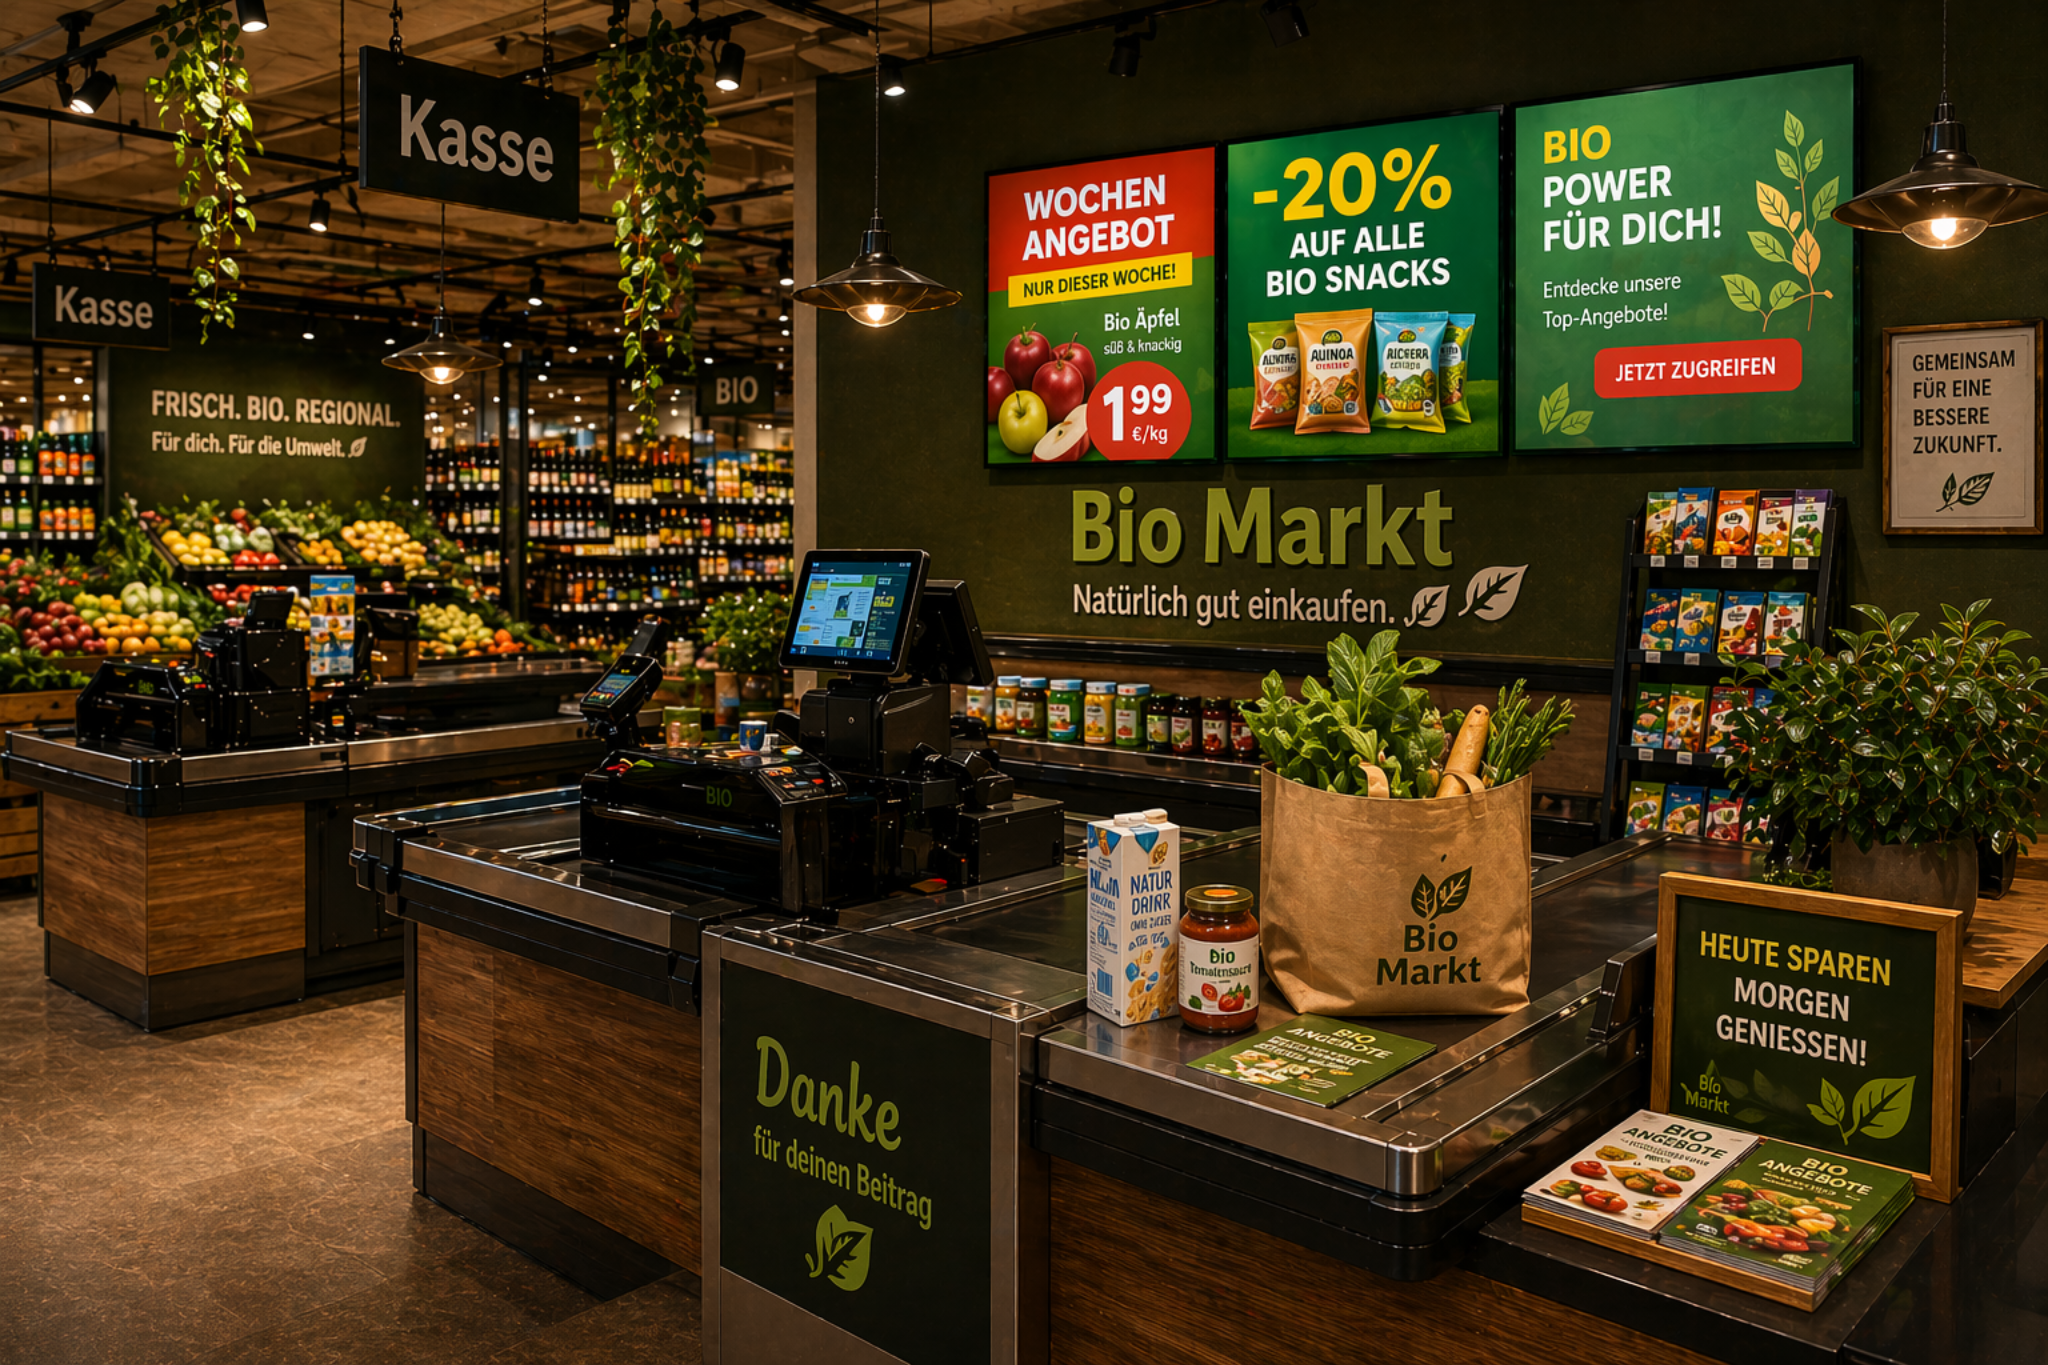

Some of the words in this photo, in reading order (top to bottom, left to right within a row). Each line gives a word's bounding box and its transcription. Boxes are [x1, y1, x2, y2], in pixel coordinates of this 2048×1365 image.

[400, 93, 555, 183] Kasse
[1544, 124, 1612, 164] BIO
[1023, 174, 1166, 221] WOCHEN
[1252, 143, 1453, 222] -20%
[1544, 164, 1672, 208] POWER
[1022, 213, 1175, 261] ANGEBOT
[1289, 228, 1347, 260] AUF
[1353, 222, 1426, 254] ALLE
[1544, 210, 1611, 252] FÜR
[1621, 204, 1723, 245] DICH!
[1023, 280, 1054, 298] NUR
[1058, 272, 1109, 294] DIESER
[1113, 262, 1176, 287] WOCHE!
[1266, 268, 1318, 298] BIO
[1325, 256, 1451, 294] SNACKS
[1543, 276, 1619, 299] Entdecke
[1624, 275, 1682, 293] unsere
[54, 284, 154, 330] Kasse
[1104, 312, 1130, 332] Bio
[1135, 307, 1181, 334] Äpfel
[1543, 303, 1669, 332] Top-Angebote!
[1126, 340, 1136, 354] &
[1138, 337, 1182, 354] knackig
[1912, 349, 2016, 373] GEMEINSAM
[1614, 362, 1666, 383] JETZT
[1671, 356, 1776, 381] ZUGREIFEN
[716, 376, 758, 404] BIO
[1912, 377, 1947, 400] FÜR
[1952, 378, 1992, 398] EINE
[152, 390, 242, 420] FRISCH.
[247, 395, 290, 422] BIO.
[296, 398, 401, 428] REGIONAL.
[1912, 406, 1990, 428] BESSERE
[152, 431, 182, 452] Für
[184, 432, 225, 454] dich.
[228, 434, 256, 454] Für
[258, 434, 282, 455] die
[285, 436, 346, 458] Umwelt.
[1132, 425, 1168, 444] €/kg
[1912, 433, 2002, 455] ZUKUNFT.
[1072, 485, 1183, 565] Bio
[1204, 483, 1454, 568] Markt
[1073, 583, 1188, 620] Natürlich
[1196, 588, 1241, 627] gut
[1247, 588, 1396, 624] einkaufen.
[706, 785, 733, 808] BIO
[1130, 870, 1173, 896] NATUR
[1403, 924, 1458, 953] Bio
[1376, 956, 1482, 986] Markt
[1701, 930, 1779, 969] HEUTE
[1786, 944, 1892, 987] SPAREN
[1734, 976, 1850, 1022] MORGEN
[1286, 1028, 1394, 1060] ANGEBOTE
[1332, 1028, 1376, 1044] BIO
[1716, 1014, 1868, 1067] GENIESSEN!
[756, 1035, 902, 1152] Danke
[1680, 1082, 1730, 1116] Markt
[1622, 1128, 1728, 1160] ANGEBOTE
[1663, 1124, 1713, 1142] BIO
[753, 1124, 780, 1162] für
[786, 1138, 851, 1190] deinen
[857, 1162, 932, 1230] Beitrag
[1758, 1160, 1873, 1196] ANGEBOTE
[1802, 1158, 1849, 1176] BIO
